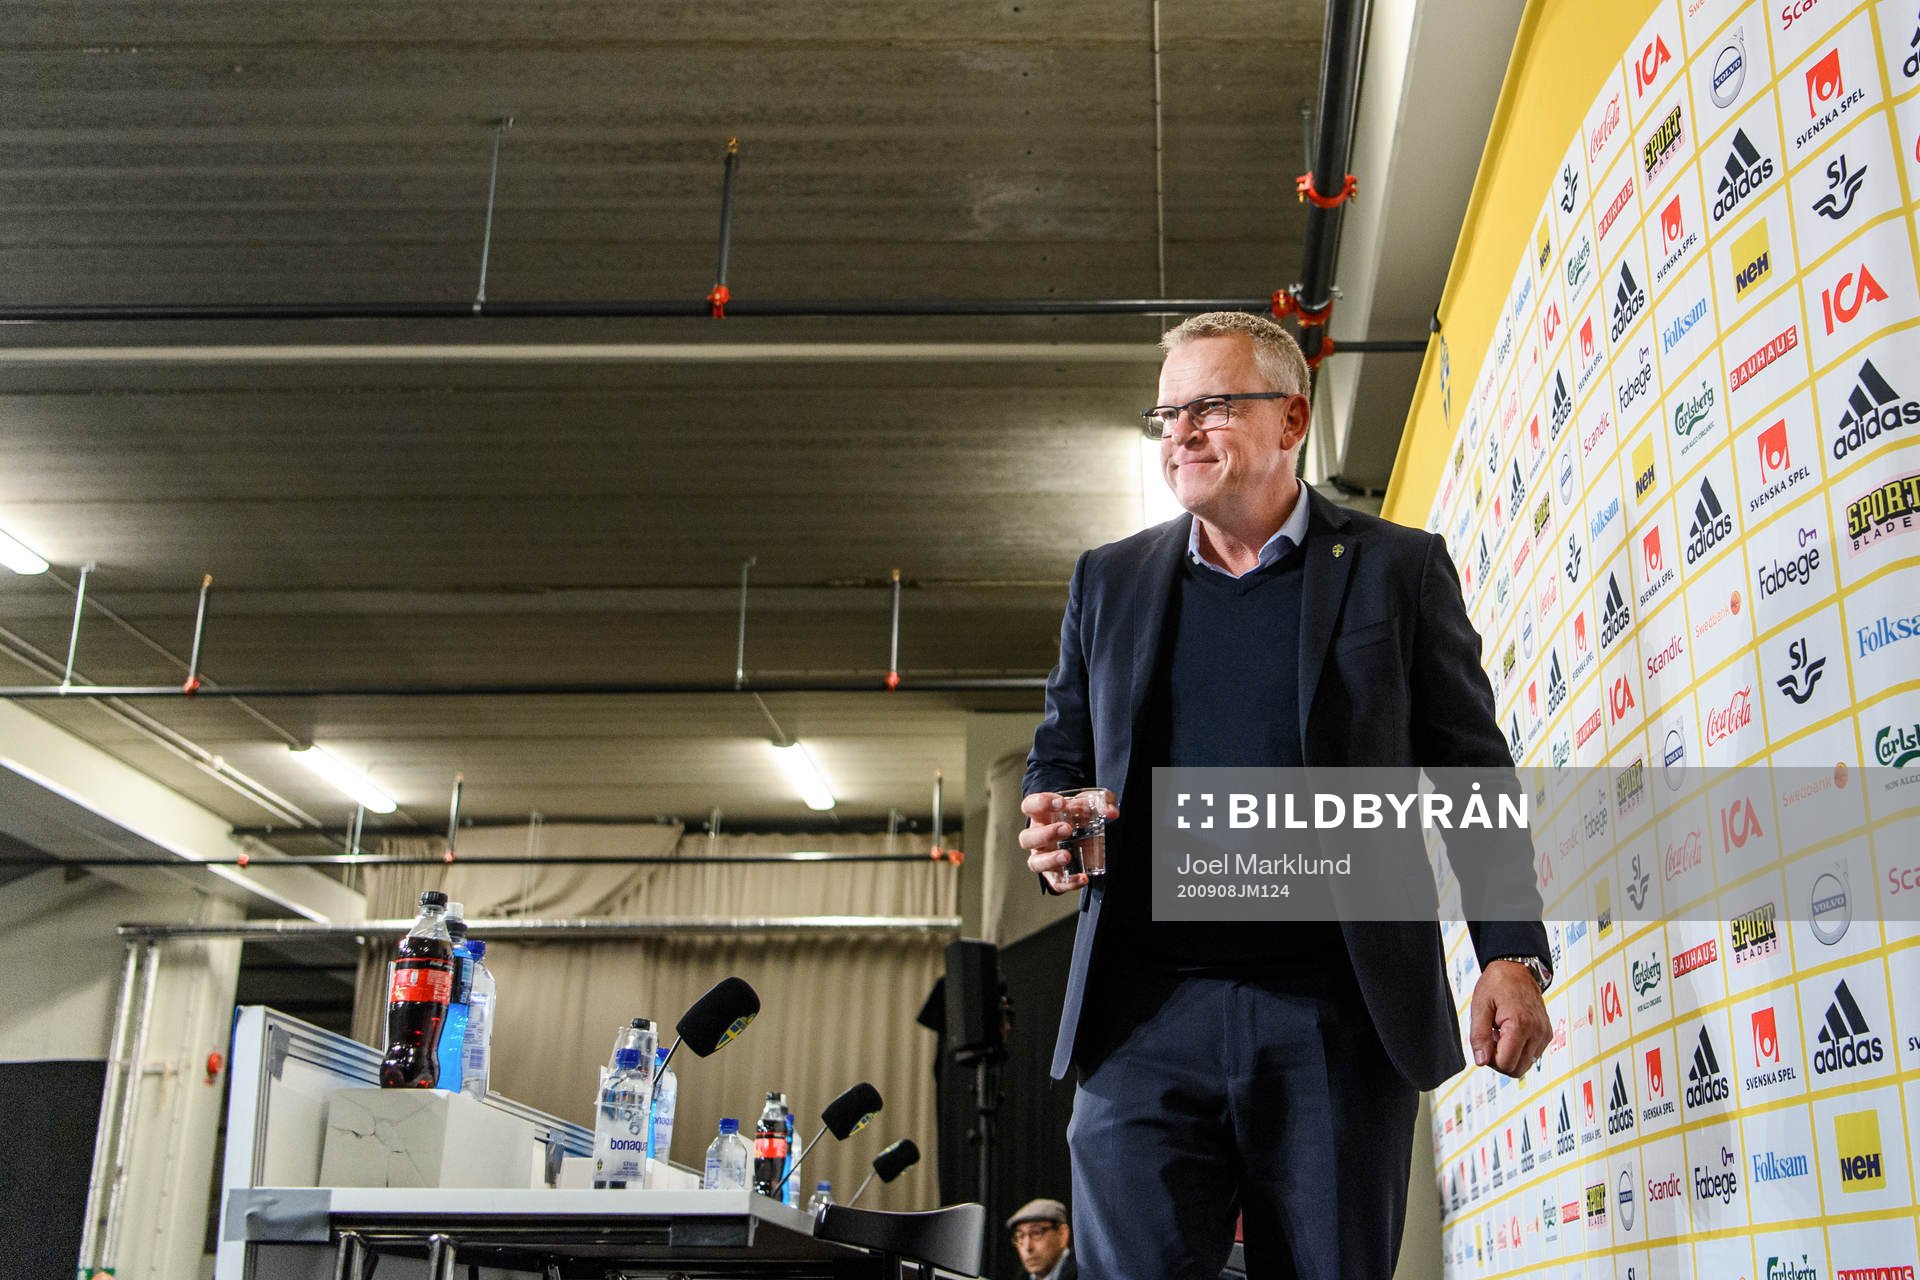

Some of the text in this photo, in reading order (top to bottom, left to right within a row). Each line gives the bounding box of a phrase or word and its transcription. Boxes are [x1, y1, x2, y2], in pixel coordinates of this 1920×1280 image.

[1635, 33, 1672, 99] ICA
[1714, 60, 1741, 86] VOLVO
[1643, 105, 1681, 173] SPORT
[1796, 88, 1865, 149] SVENSKA SPEL
[1648, 136, 1683, 181] BLADET
[1826, 154, 1847, 189] SJ
[1598, 178, 1633, 241] BAUHAUS
[1713, 157, 1773, 222] adidas
[1656, 232, 1698, 282] SVENSKA SPEL
[1611, 288, 1644, 343] adidas
[1821, 263, 1889, 336] ICA
[1543, 299, 1561, 350] ICA
[1663, 297, 1708, 355] Folksam
[1731, 327, 1797, 389] BAUHAUS
[1618, 363, 1652, 414] Fabege
[1675, 386, 1714, 436] Carlsberg
[1583, 411, 1610, 458] Scandic
[1833, 401, 1920, 460] adidas
[1750, 466, 1811, 512] SVENSKA SPEL
[1847, 474, 1920, 539] SPORT
[1591, 497, 1619, 543] Folksam
[1687, 513, 1732, 565] adidas
[1640, 569, 1675, 607] SVENSKA SPEL
[1758, 548, 1820, 600] Fabege
[1601, 606, 1630, 649] adidas
[1695, 605, 1729, 638] Swedbank
[1647, 635, 1684, 679] Scandic
[1789, 637, 1807, 670] SJ
[1609, 673, 1635, 727] ICA
[1616, 758, 1643, 807] SPORT
[1782, 773, 1833, 807] Swedbank
[1721, 795, 1763, 854] ICA
[1730, 902, 1776, 953] SPORT
[1813, 896, 1844, 914] VOLVO
[1673, 941, 1716, 976] BAUHAUS
[1736, 940, 1777, 964] BLADET
[1633, 960, 1661, 992] Carlsberg
[1600, 980, 1623, 1027] ICA
[1814, 1035, 1884, 1075] adidas
[1686, 1075, 1729, 1109] adidas
[1746, 1067, 1796, 1091] SVENSKA SPEL
[1608, 1108, 1634, 1135] adidas
[1662, 1101, 1675, 1115] SPEL
[1647, 1173, 1682, 1202] Scandic
[1694, 1165, 1737, 1205] Fabege
[1752, 1152, 1808, 1183] Folksam
[1840, 1154, 1881, 1182] NeH
